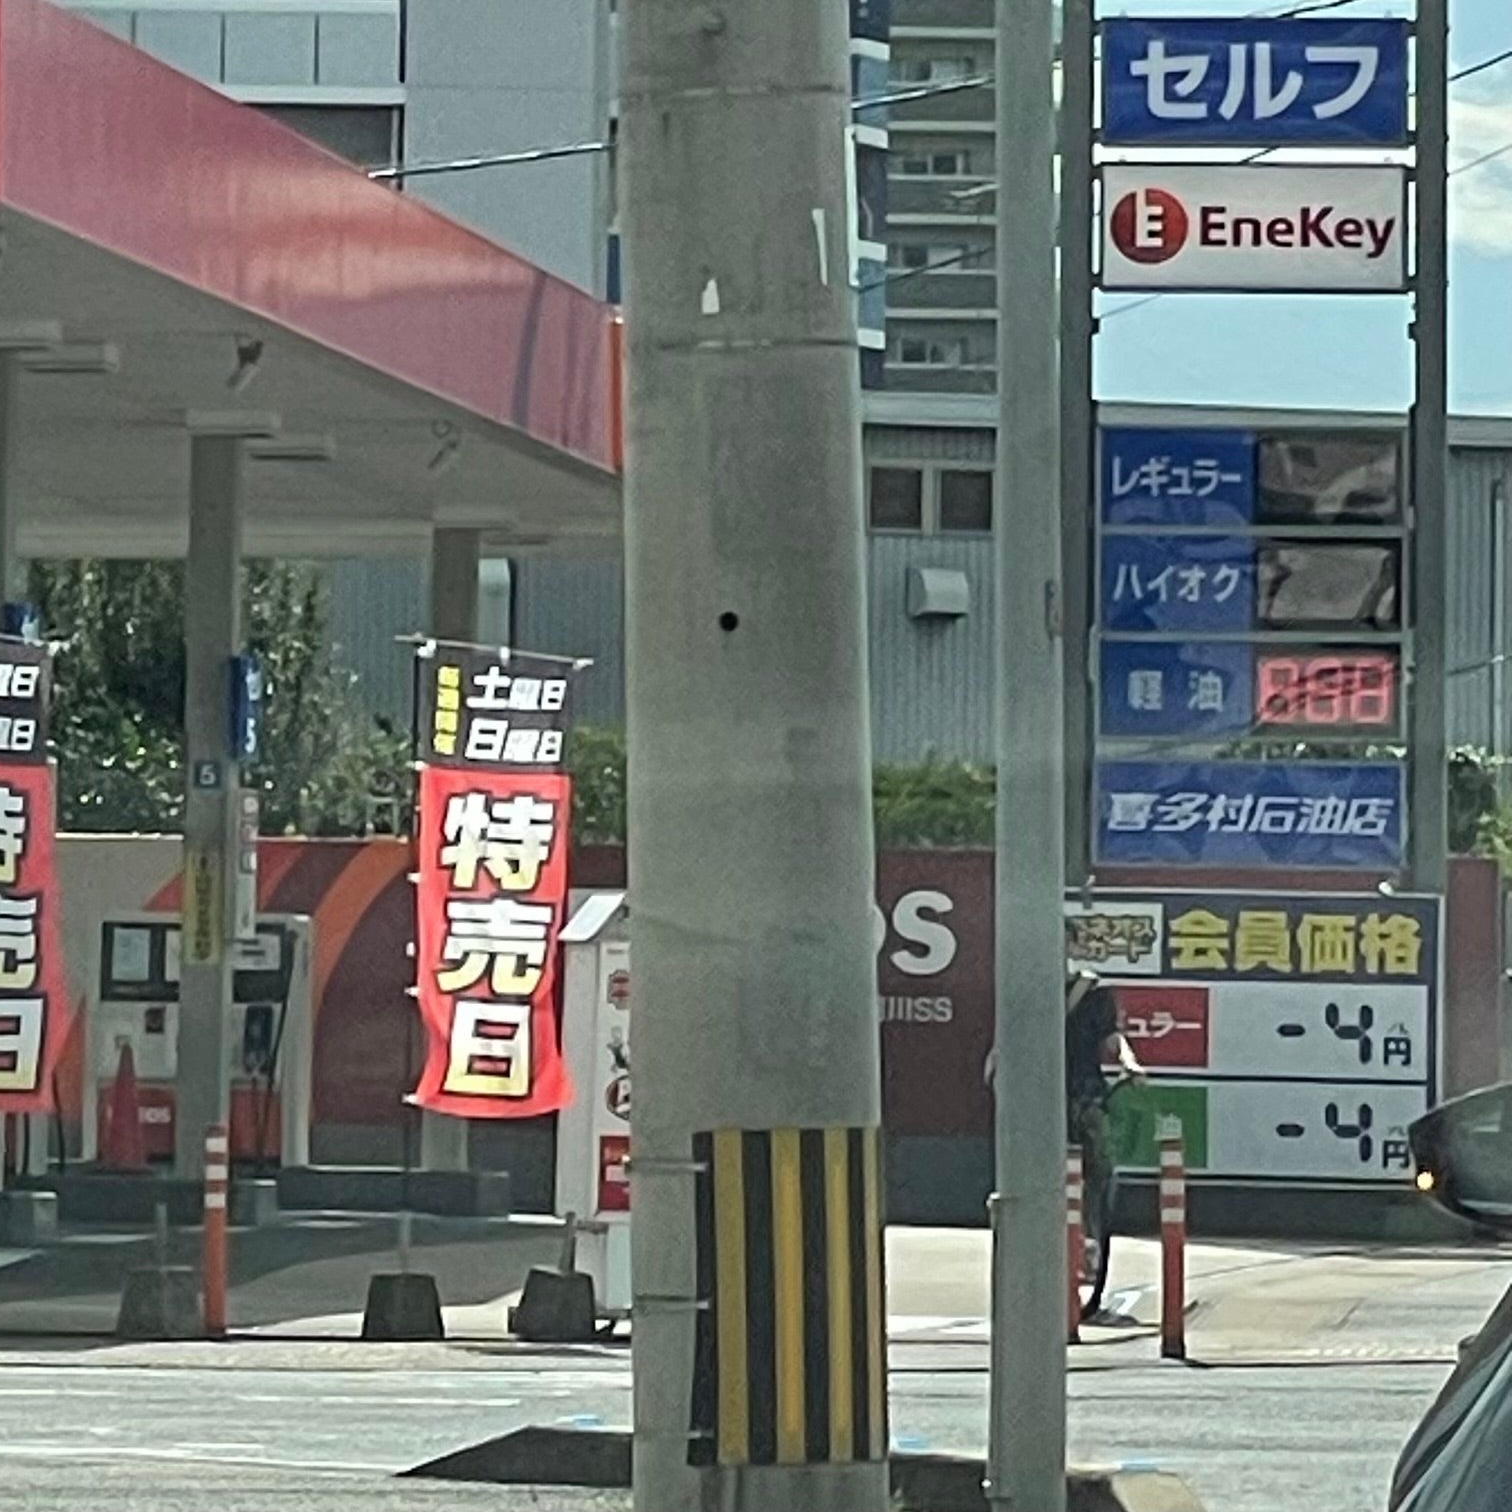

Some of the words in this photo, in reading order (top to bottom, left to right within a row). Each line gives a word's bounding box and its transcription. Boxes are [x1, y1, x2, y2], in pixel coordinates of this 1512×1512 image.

[1129, 40, 1379, 121] セルフ
[1199, 205, 1397, 259] EneKey
[1111, 455, 1243, 498] レギュラー
[1112, 562, 1242, 603] ハイオク
[1127, 668, 1225, 714] 軽油
[1107, 791, 1395, 836] 喜多村石油店
[437, 791, 554, 1096] 特売日
[1167, 909, 1422, 975] 会員価格
[1116, 1011, 1203, 1038] ュラー
[1383, 1037, 1412, 1067] 円
